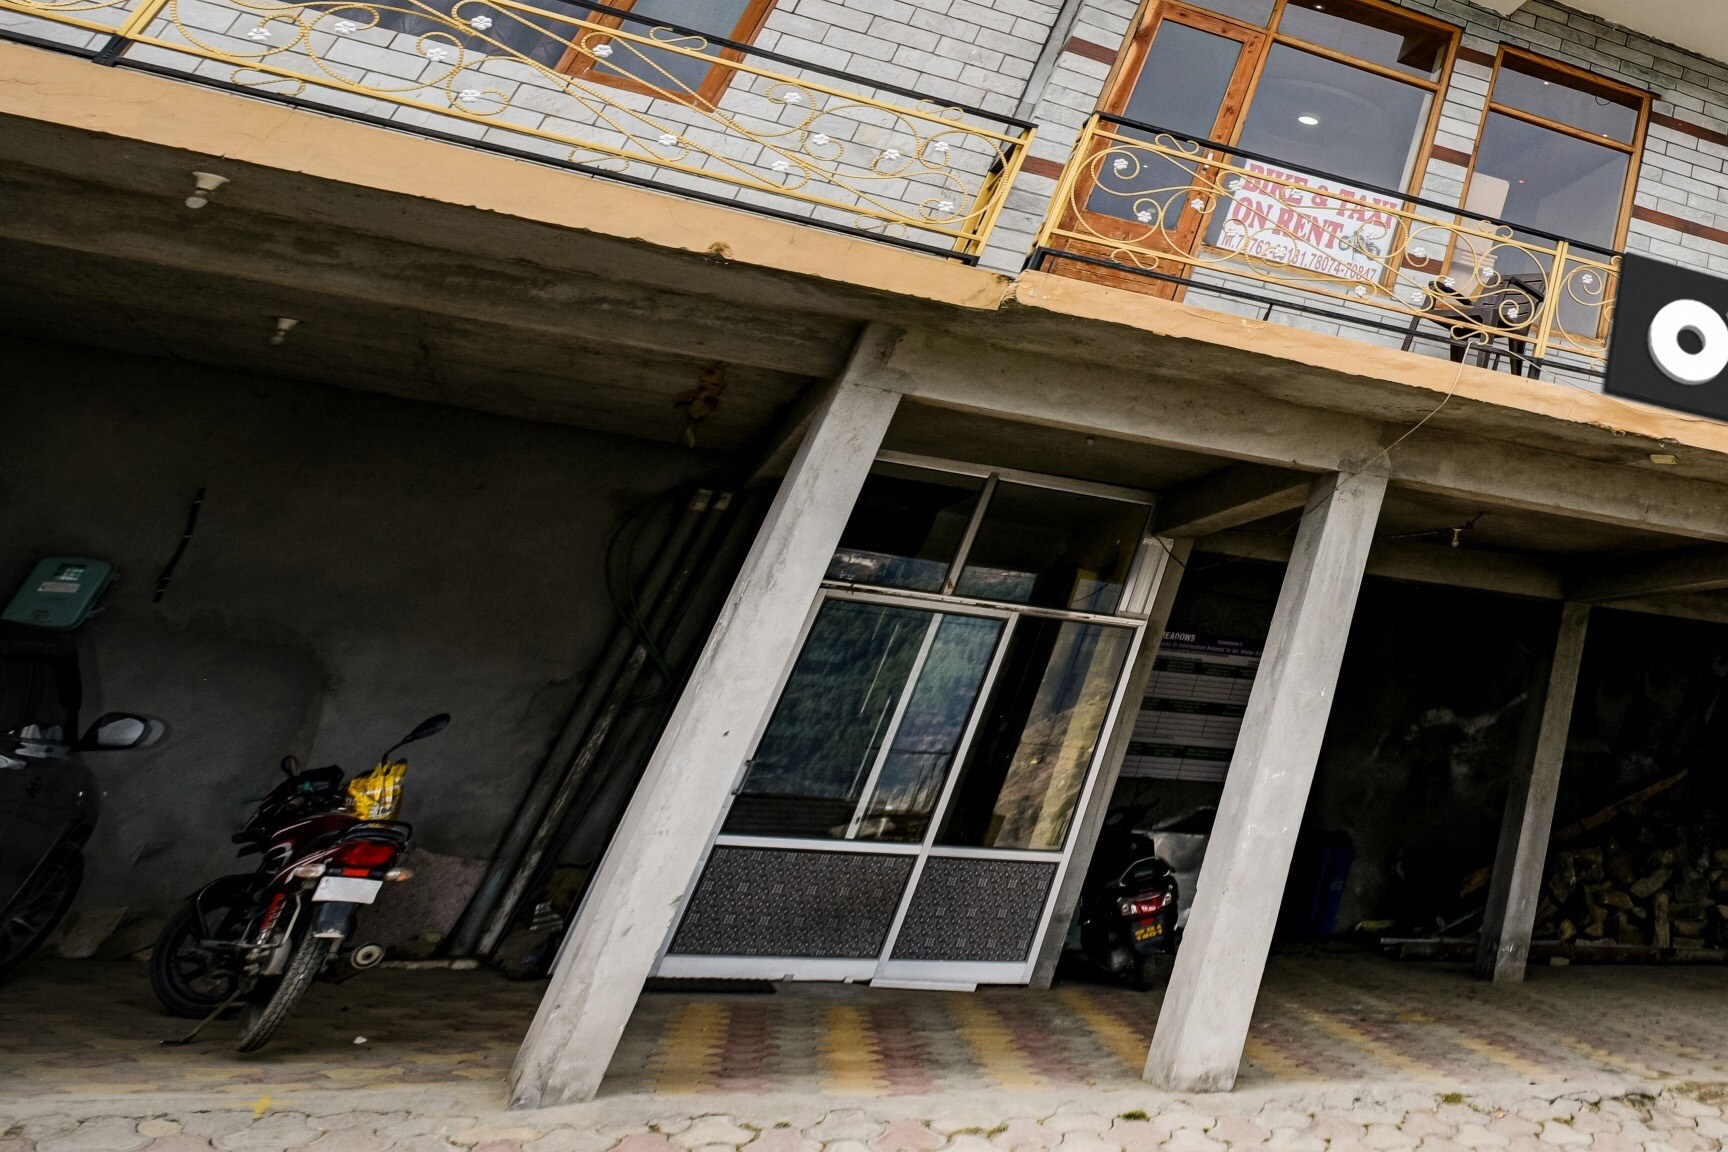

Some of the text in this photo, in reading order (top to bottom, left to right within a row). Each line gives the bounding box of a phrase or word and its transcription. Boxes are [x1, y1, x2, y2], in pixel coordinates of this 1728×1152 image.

[1231, 196, 1345, 250] ON RENT
[1242, 163, 1398, 232] BIKE & TAXI
[1163, 631, 1196, 642] EADOWS
